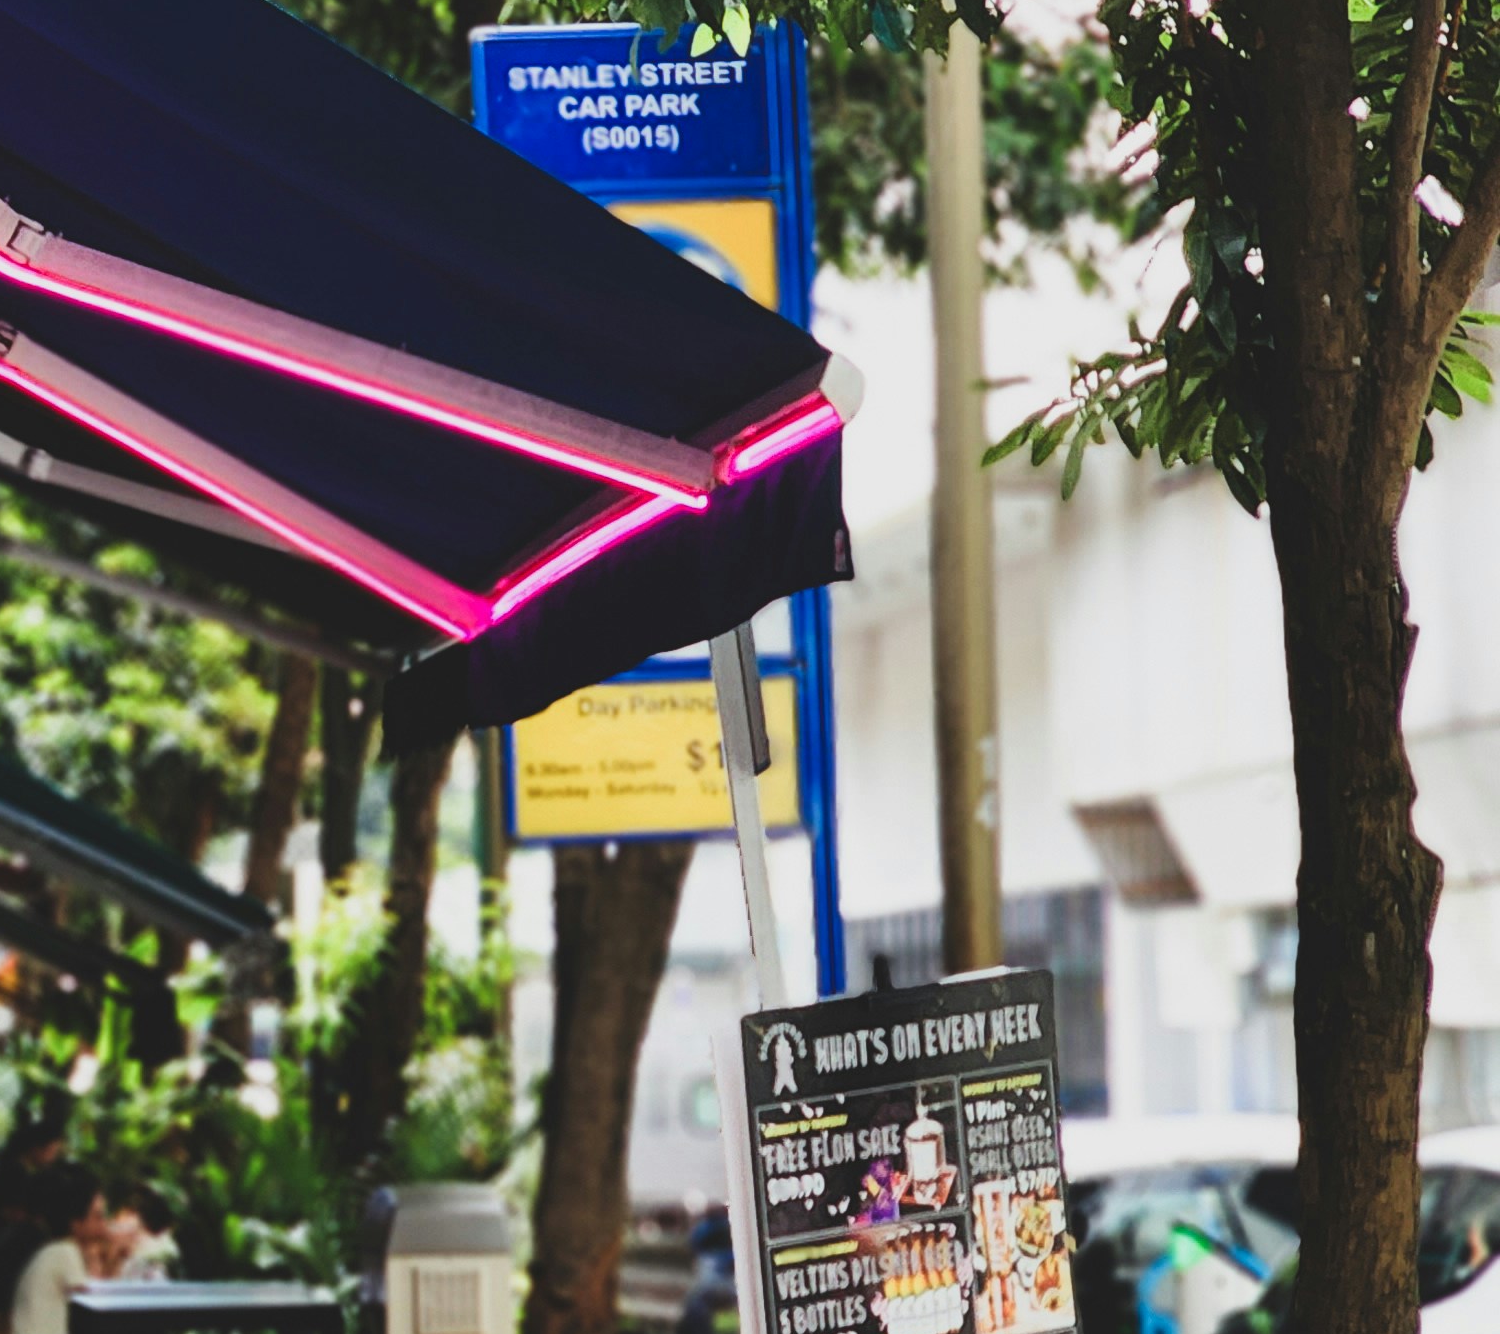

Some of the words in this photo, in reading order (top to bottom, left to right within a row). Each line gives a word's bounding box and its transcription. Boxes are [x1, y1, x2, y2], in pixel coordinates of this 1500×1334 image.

[507, 65, 632, 91] STANLEY
[639, 60, 747, 86] STREET
[558, 94, 618, 120] CAR
[624, 93, 701, 117] PARK
[581, 124, 680, 154] (S0015)
[814, 1027, 888, 1075] WHAT'S
[891, 1023, 921, 1063] ON
[923, 1012, 990, 1057] EVERY
[761, 1138, 809, 1176] FREE
